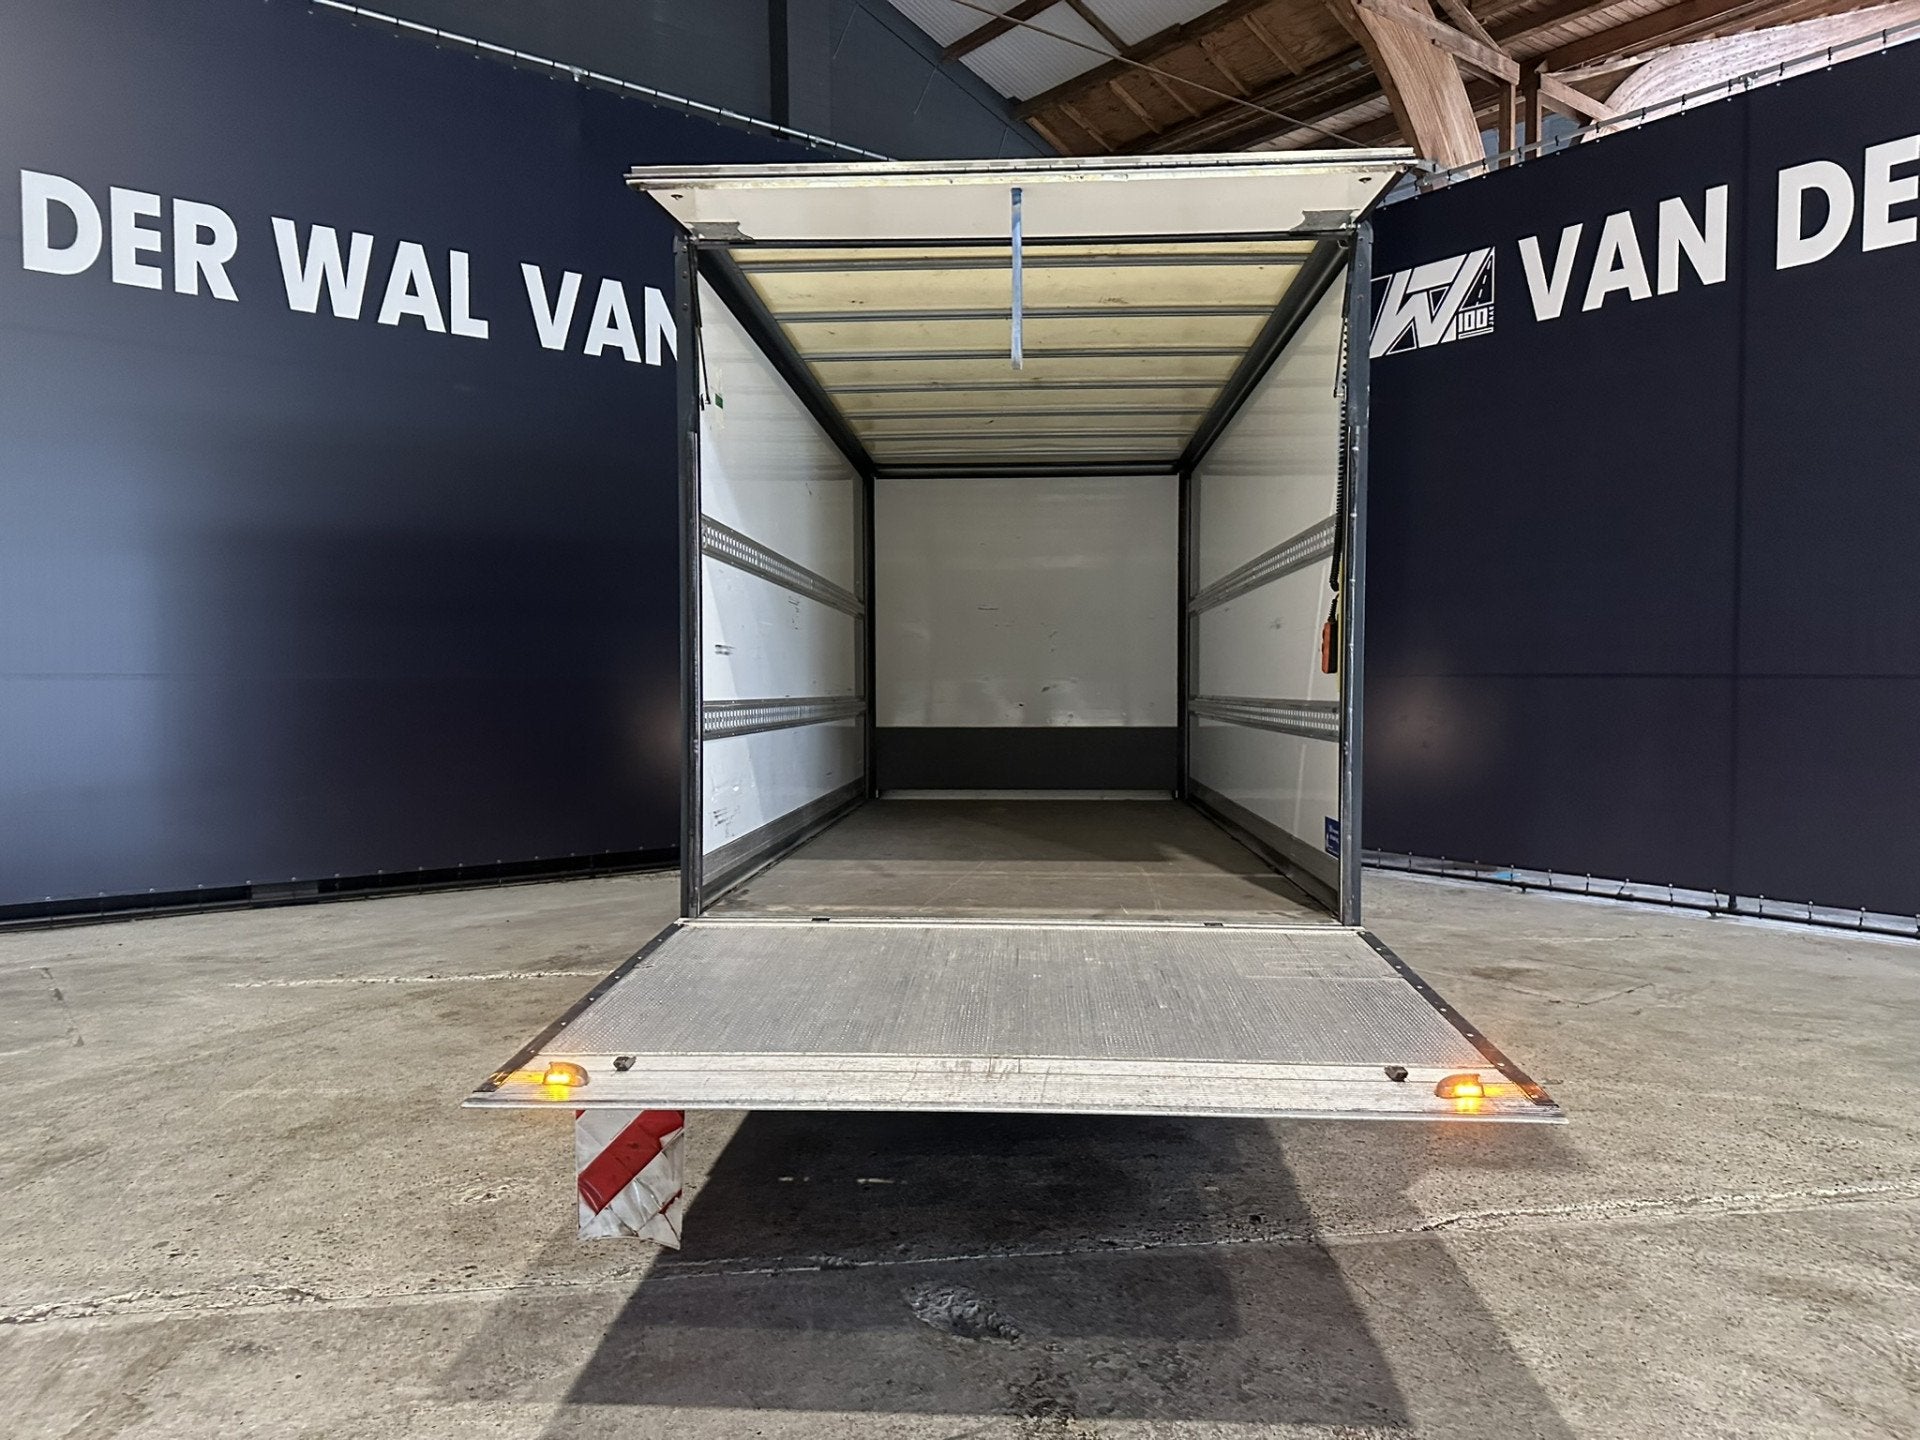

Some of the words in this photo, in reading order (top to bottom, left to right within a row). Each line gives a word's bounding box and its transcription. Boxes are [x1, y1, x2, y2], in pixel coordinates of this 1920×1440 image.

[20, 169, 240, 302] DER
[271, 216, 489, 340] WAL
[520, 262, 678, 367] VAN
[1458, 307, 1488, 333] 100
[1517, 184, 1728, 322] VAN
[1776, 134, 1920, 270] DE
